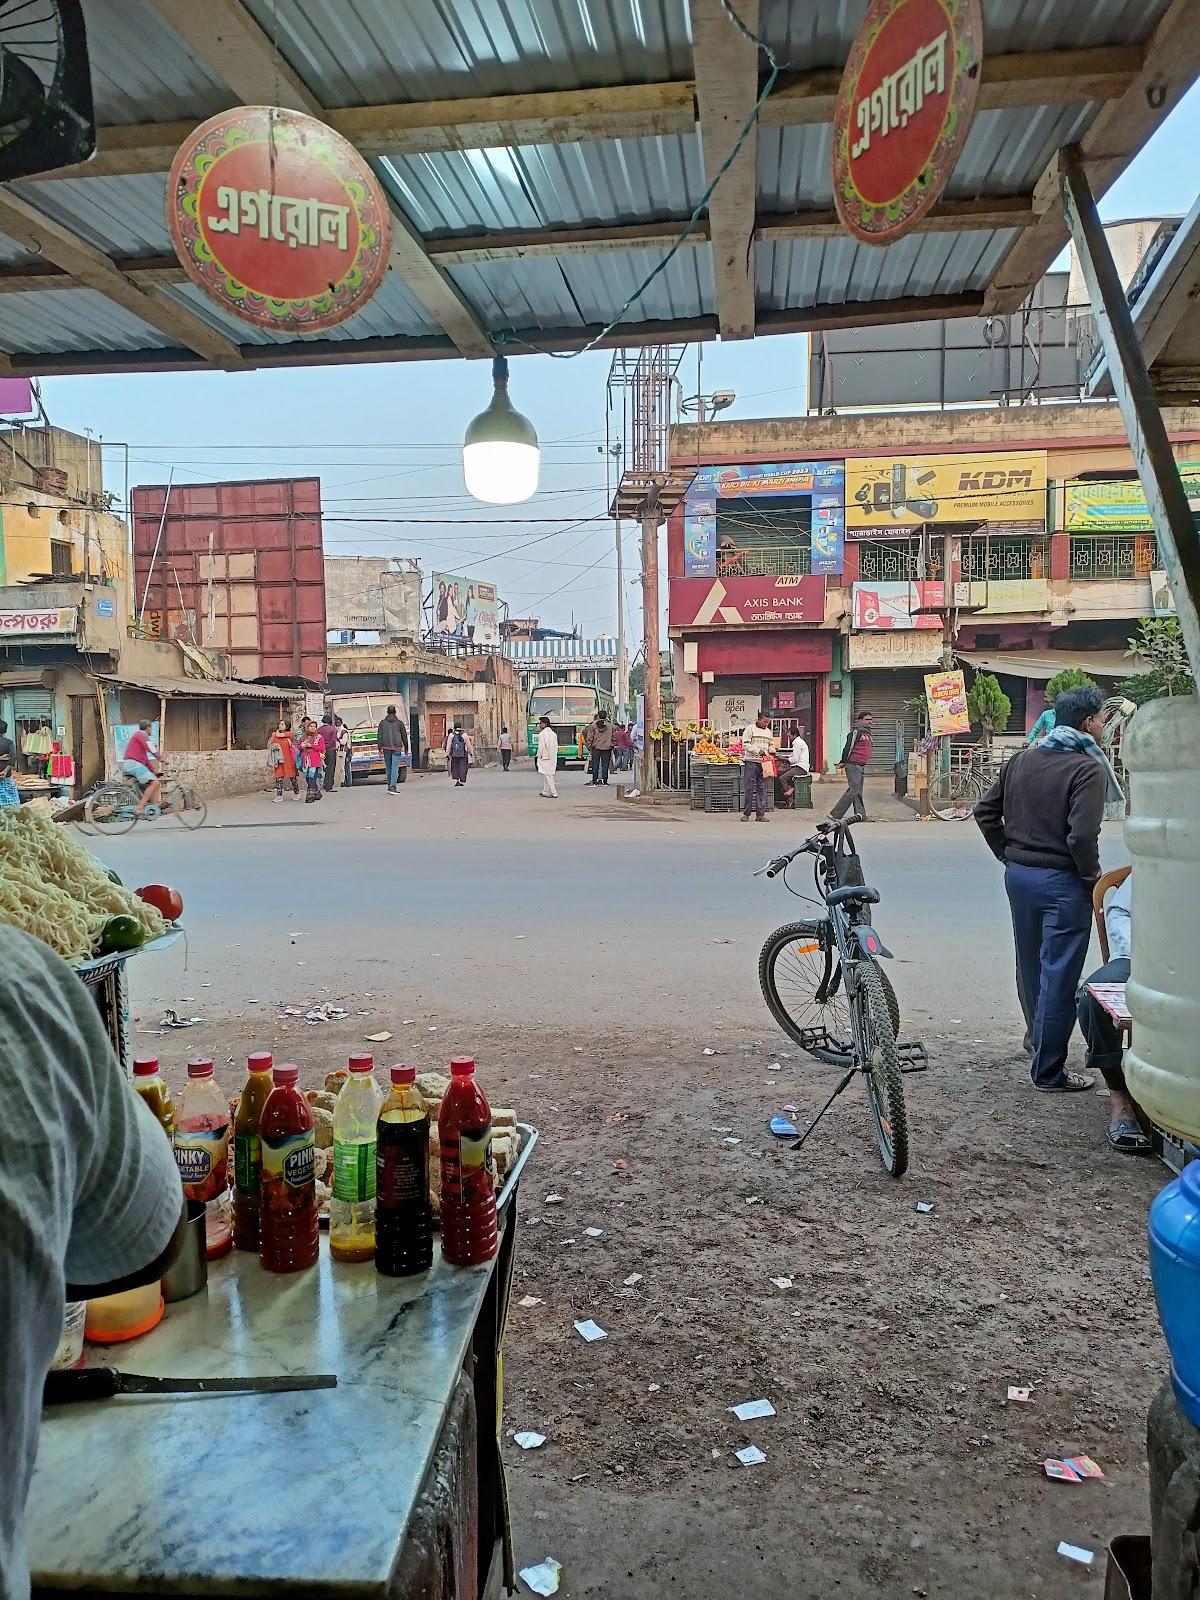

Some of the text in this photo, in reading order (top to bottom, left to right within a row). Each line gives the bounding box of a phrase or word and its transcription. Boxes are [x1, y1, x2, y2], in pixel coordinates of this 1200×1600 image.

[852, 31, 947, 159] এগরোল
[207, 185, 350, 250] এগরোল
[761, 477, 785, 486] MARZI
[958, 470, 1033, 491] KDM
[979, 500, 998, 508] MOBILE
[1000, 499, 1034, 507] ACCESSORIES
[777, 577, 799, 585] ATM
[743, 597, 804, 608] AXIS BANK
[0, 613, 58, 630] ল্পতরু
[725, 698, 735, 706] dil
[724, 704, 745, 713] open
